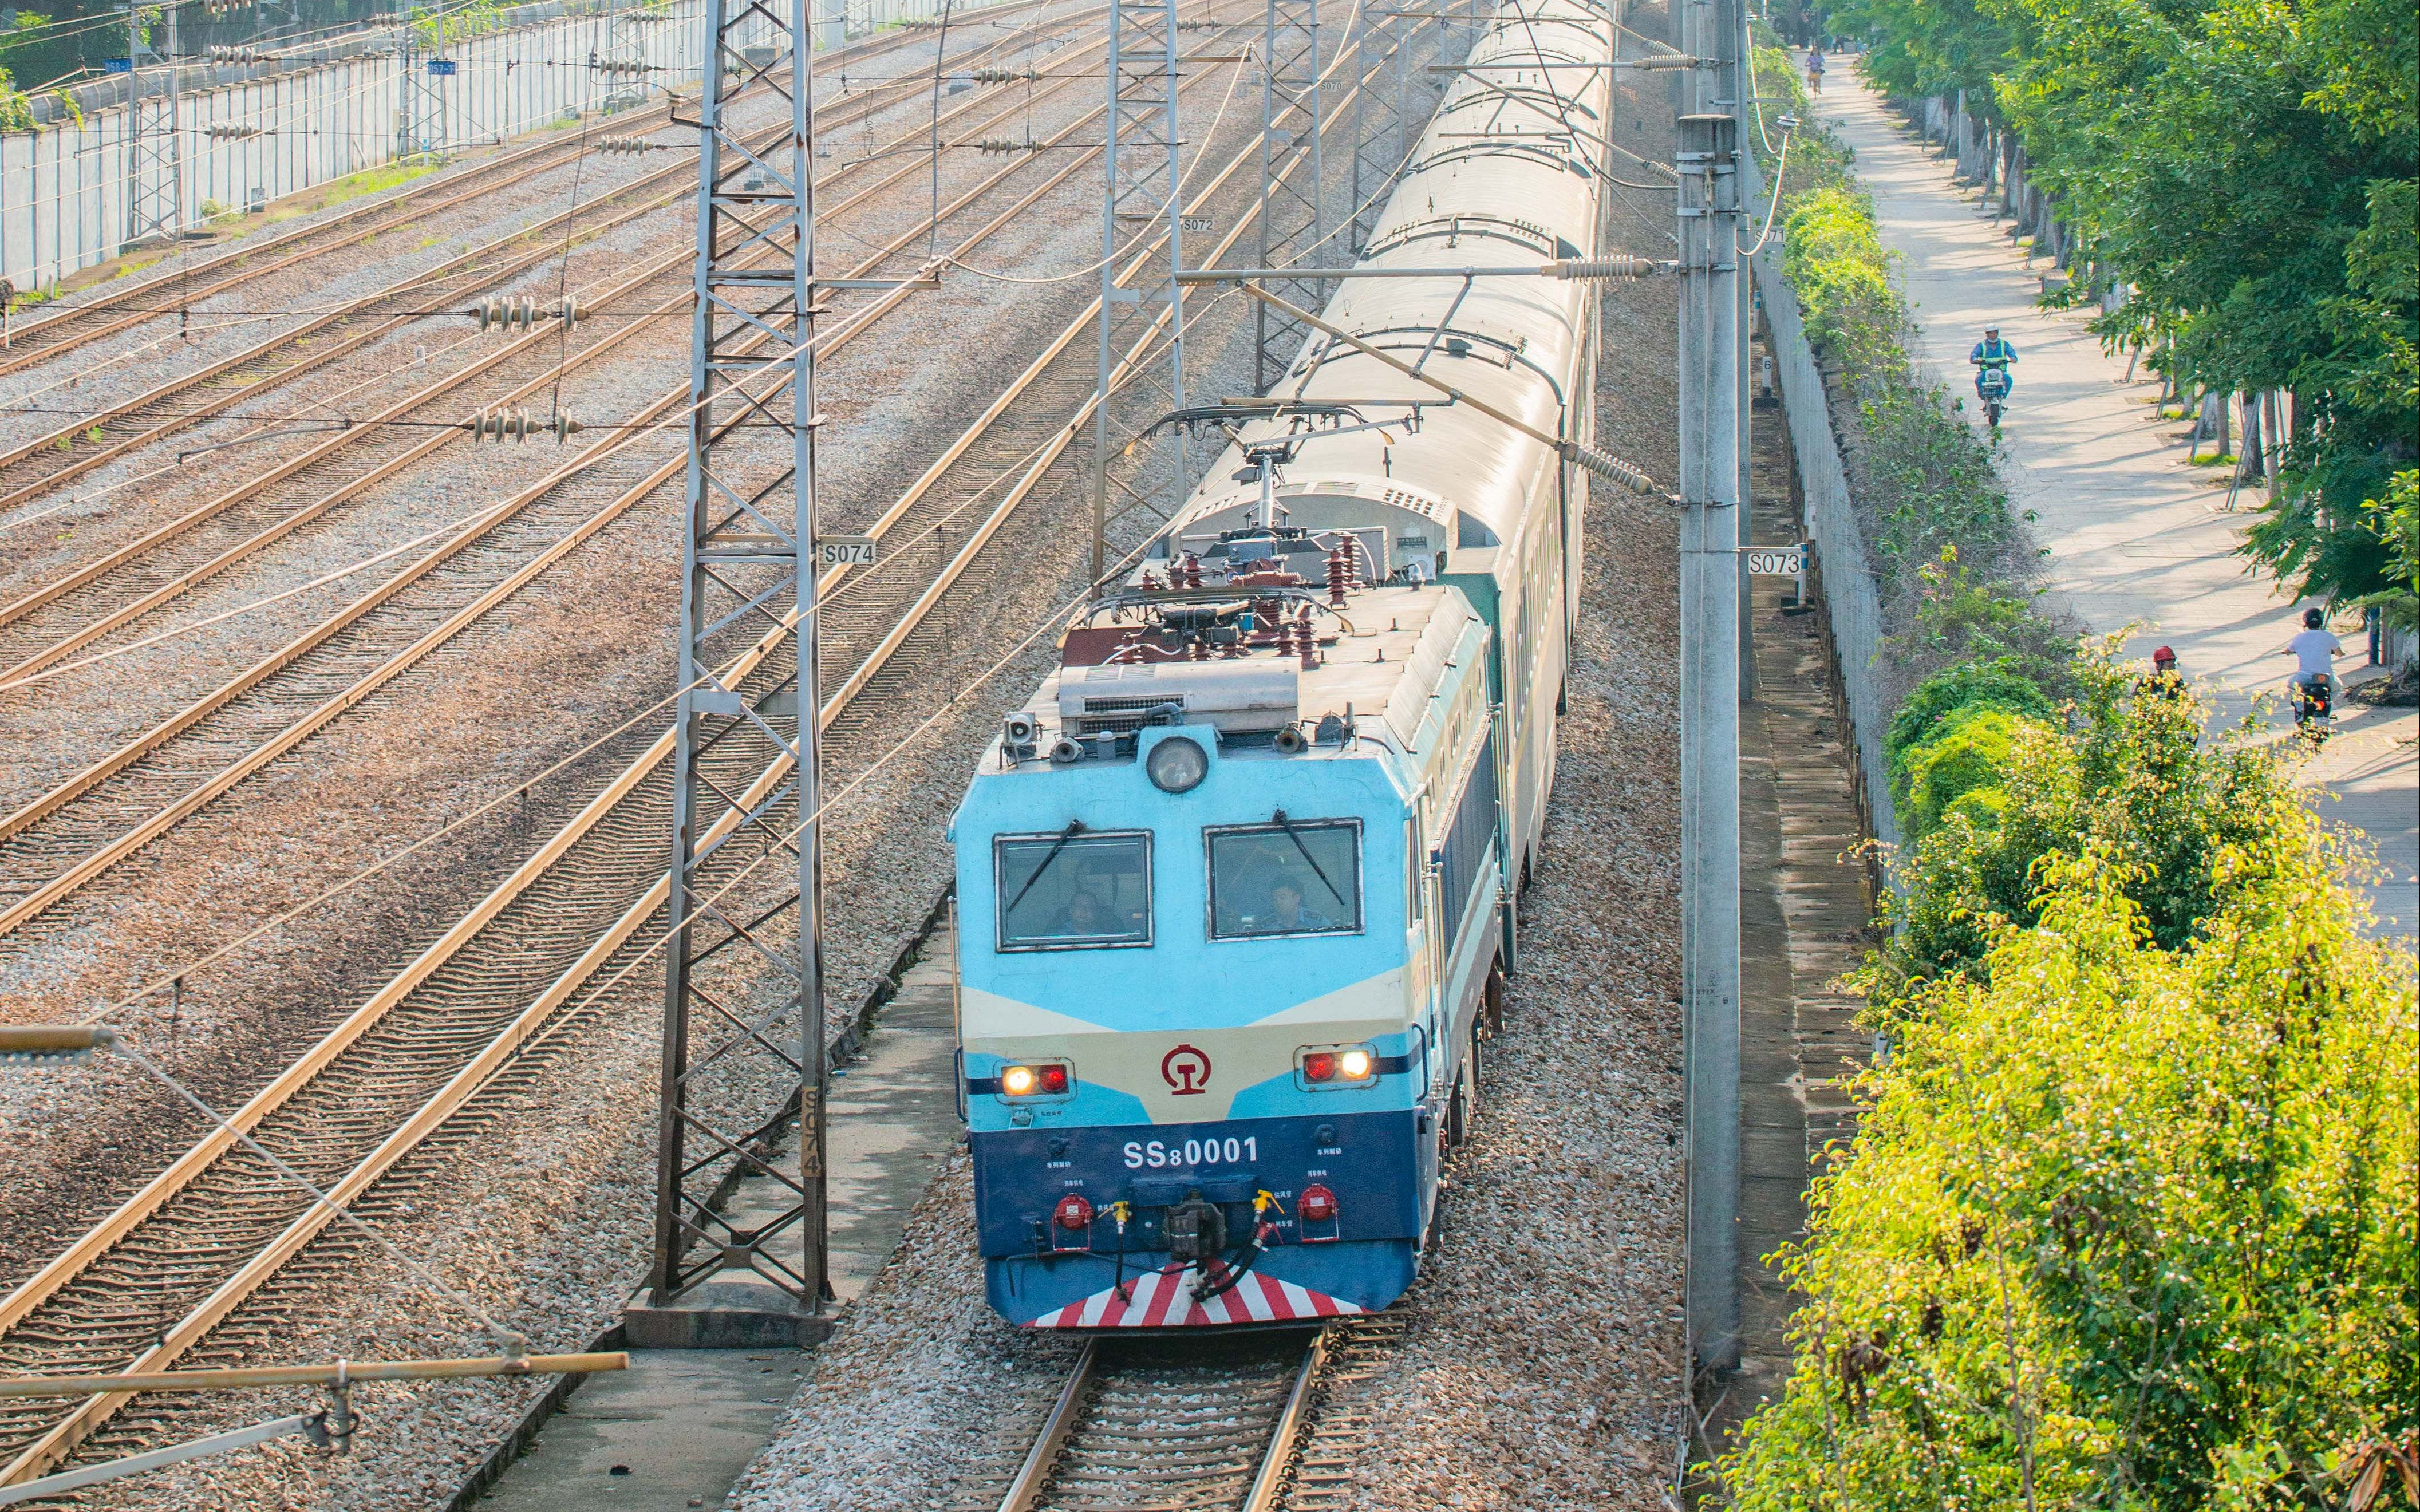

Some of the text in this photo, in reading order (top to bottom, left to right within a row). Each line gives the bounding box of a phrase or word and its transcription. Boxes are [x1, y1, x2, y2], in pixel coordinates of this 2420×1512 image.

[429, 64, 455, 74] 057-下
[1321, 82, 1342, 90] S070
[1184, 219, 1213, 230] S072
[1755, 230, 1784, 241] S071
[1764, 360, 1771, 369] 6
[825, 545, 874, 563] S074
[1750, 554, 1800, 573] S073
[804, 1091, 819, 1173] S074
[1124, 1136, 1257, 1168] SS80001
[1317, 1147, 1342, 1155] 车列制动
[1047, 1160, 1071, 1168] 车列制动
[1274, 1190, 1292, 1198] 供风管
